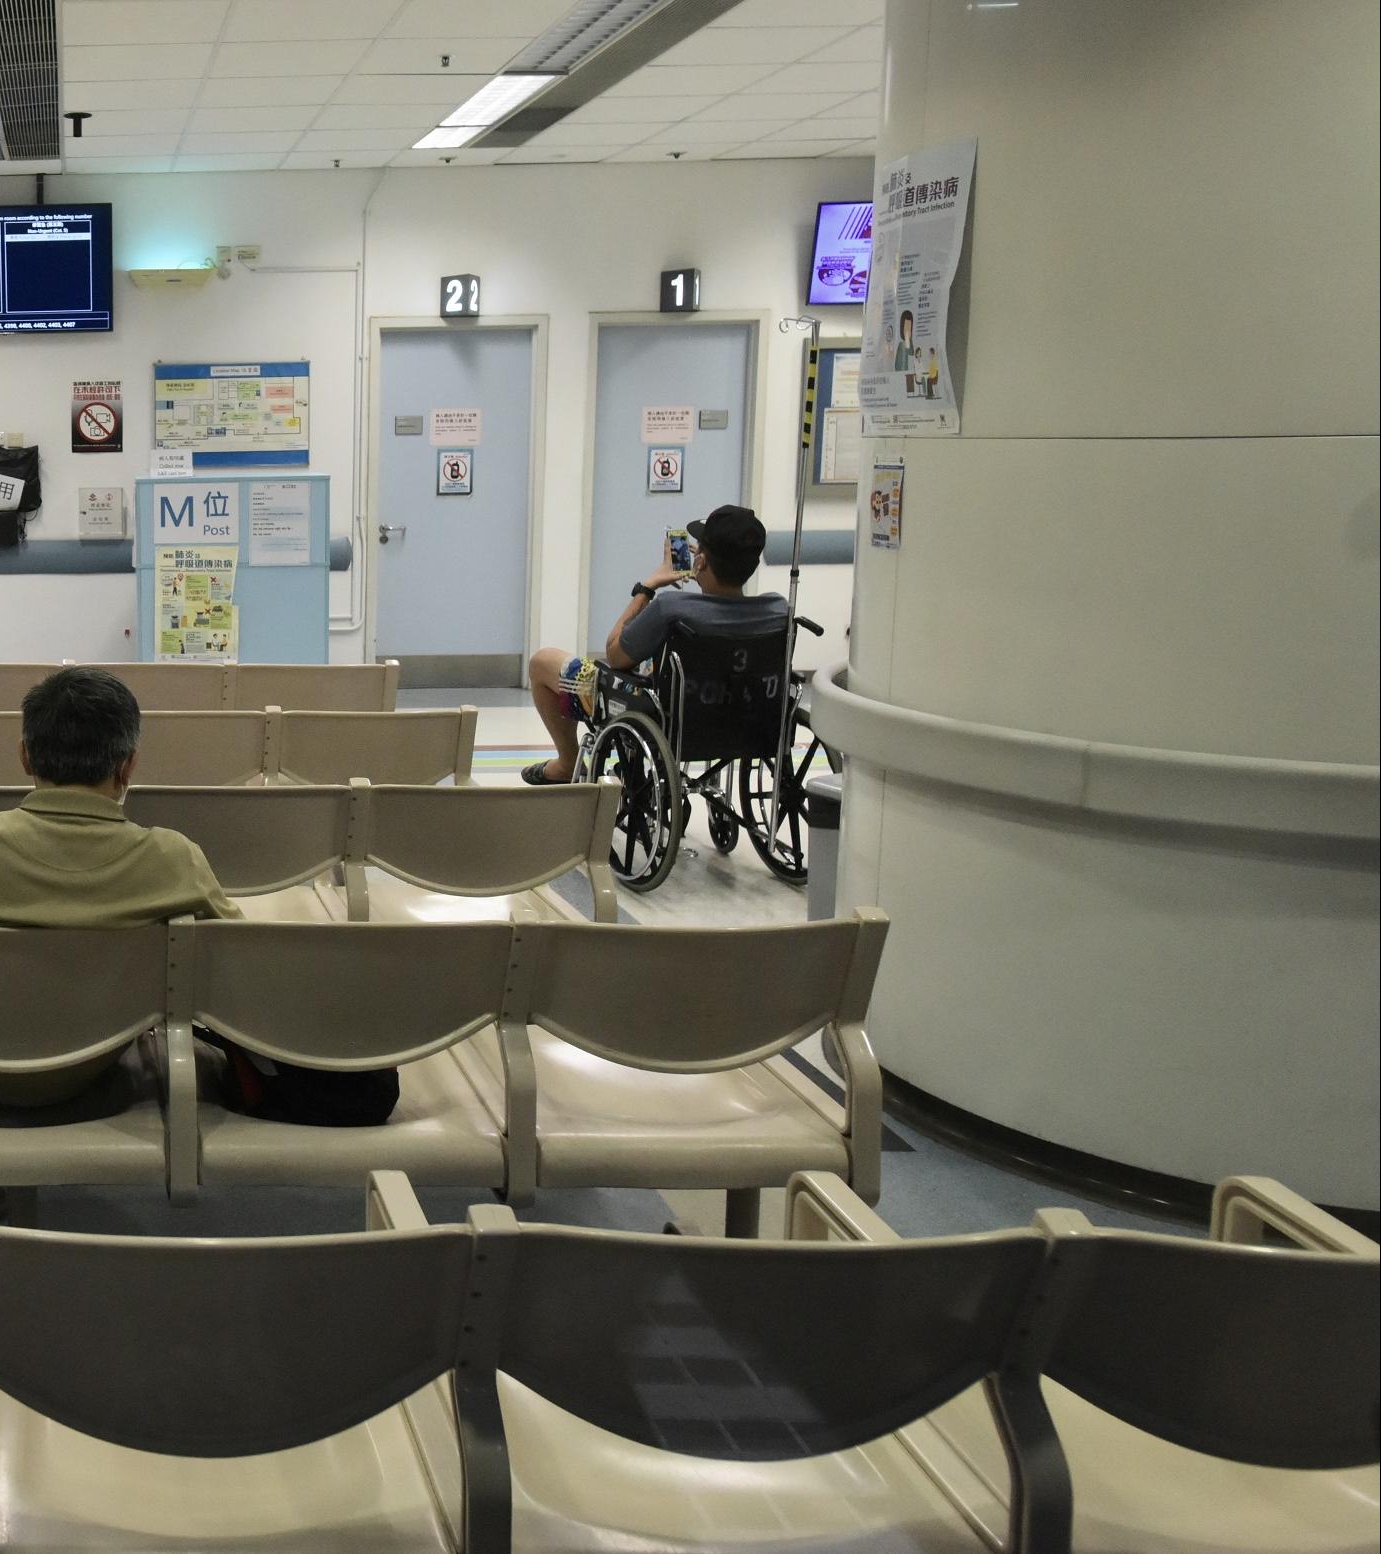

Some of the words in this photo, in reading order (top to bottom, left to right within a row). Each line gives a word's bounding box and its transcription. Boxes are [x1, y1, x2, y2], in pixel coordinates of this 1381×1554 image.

[446, 279, 463, 312] 2
[470, 279, 478, 312] 2
[671, 273, 683, 306] 1
[160, 496, 193, 528] M
[203, 491, 230, 518] 位
[203, 524, 230, 536] Post
[175, 559, 233, 568] 呼吸道傳染病
[733, 648, 748, 672] 3
